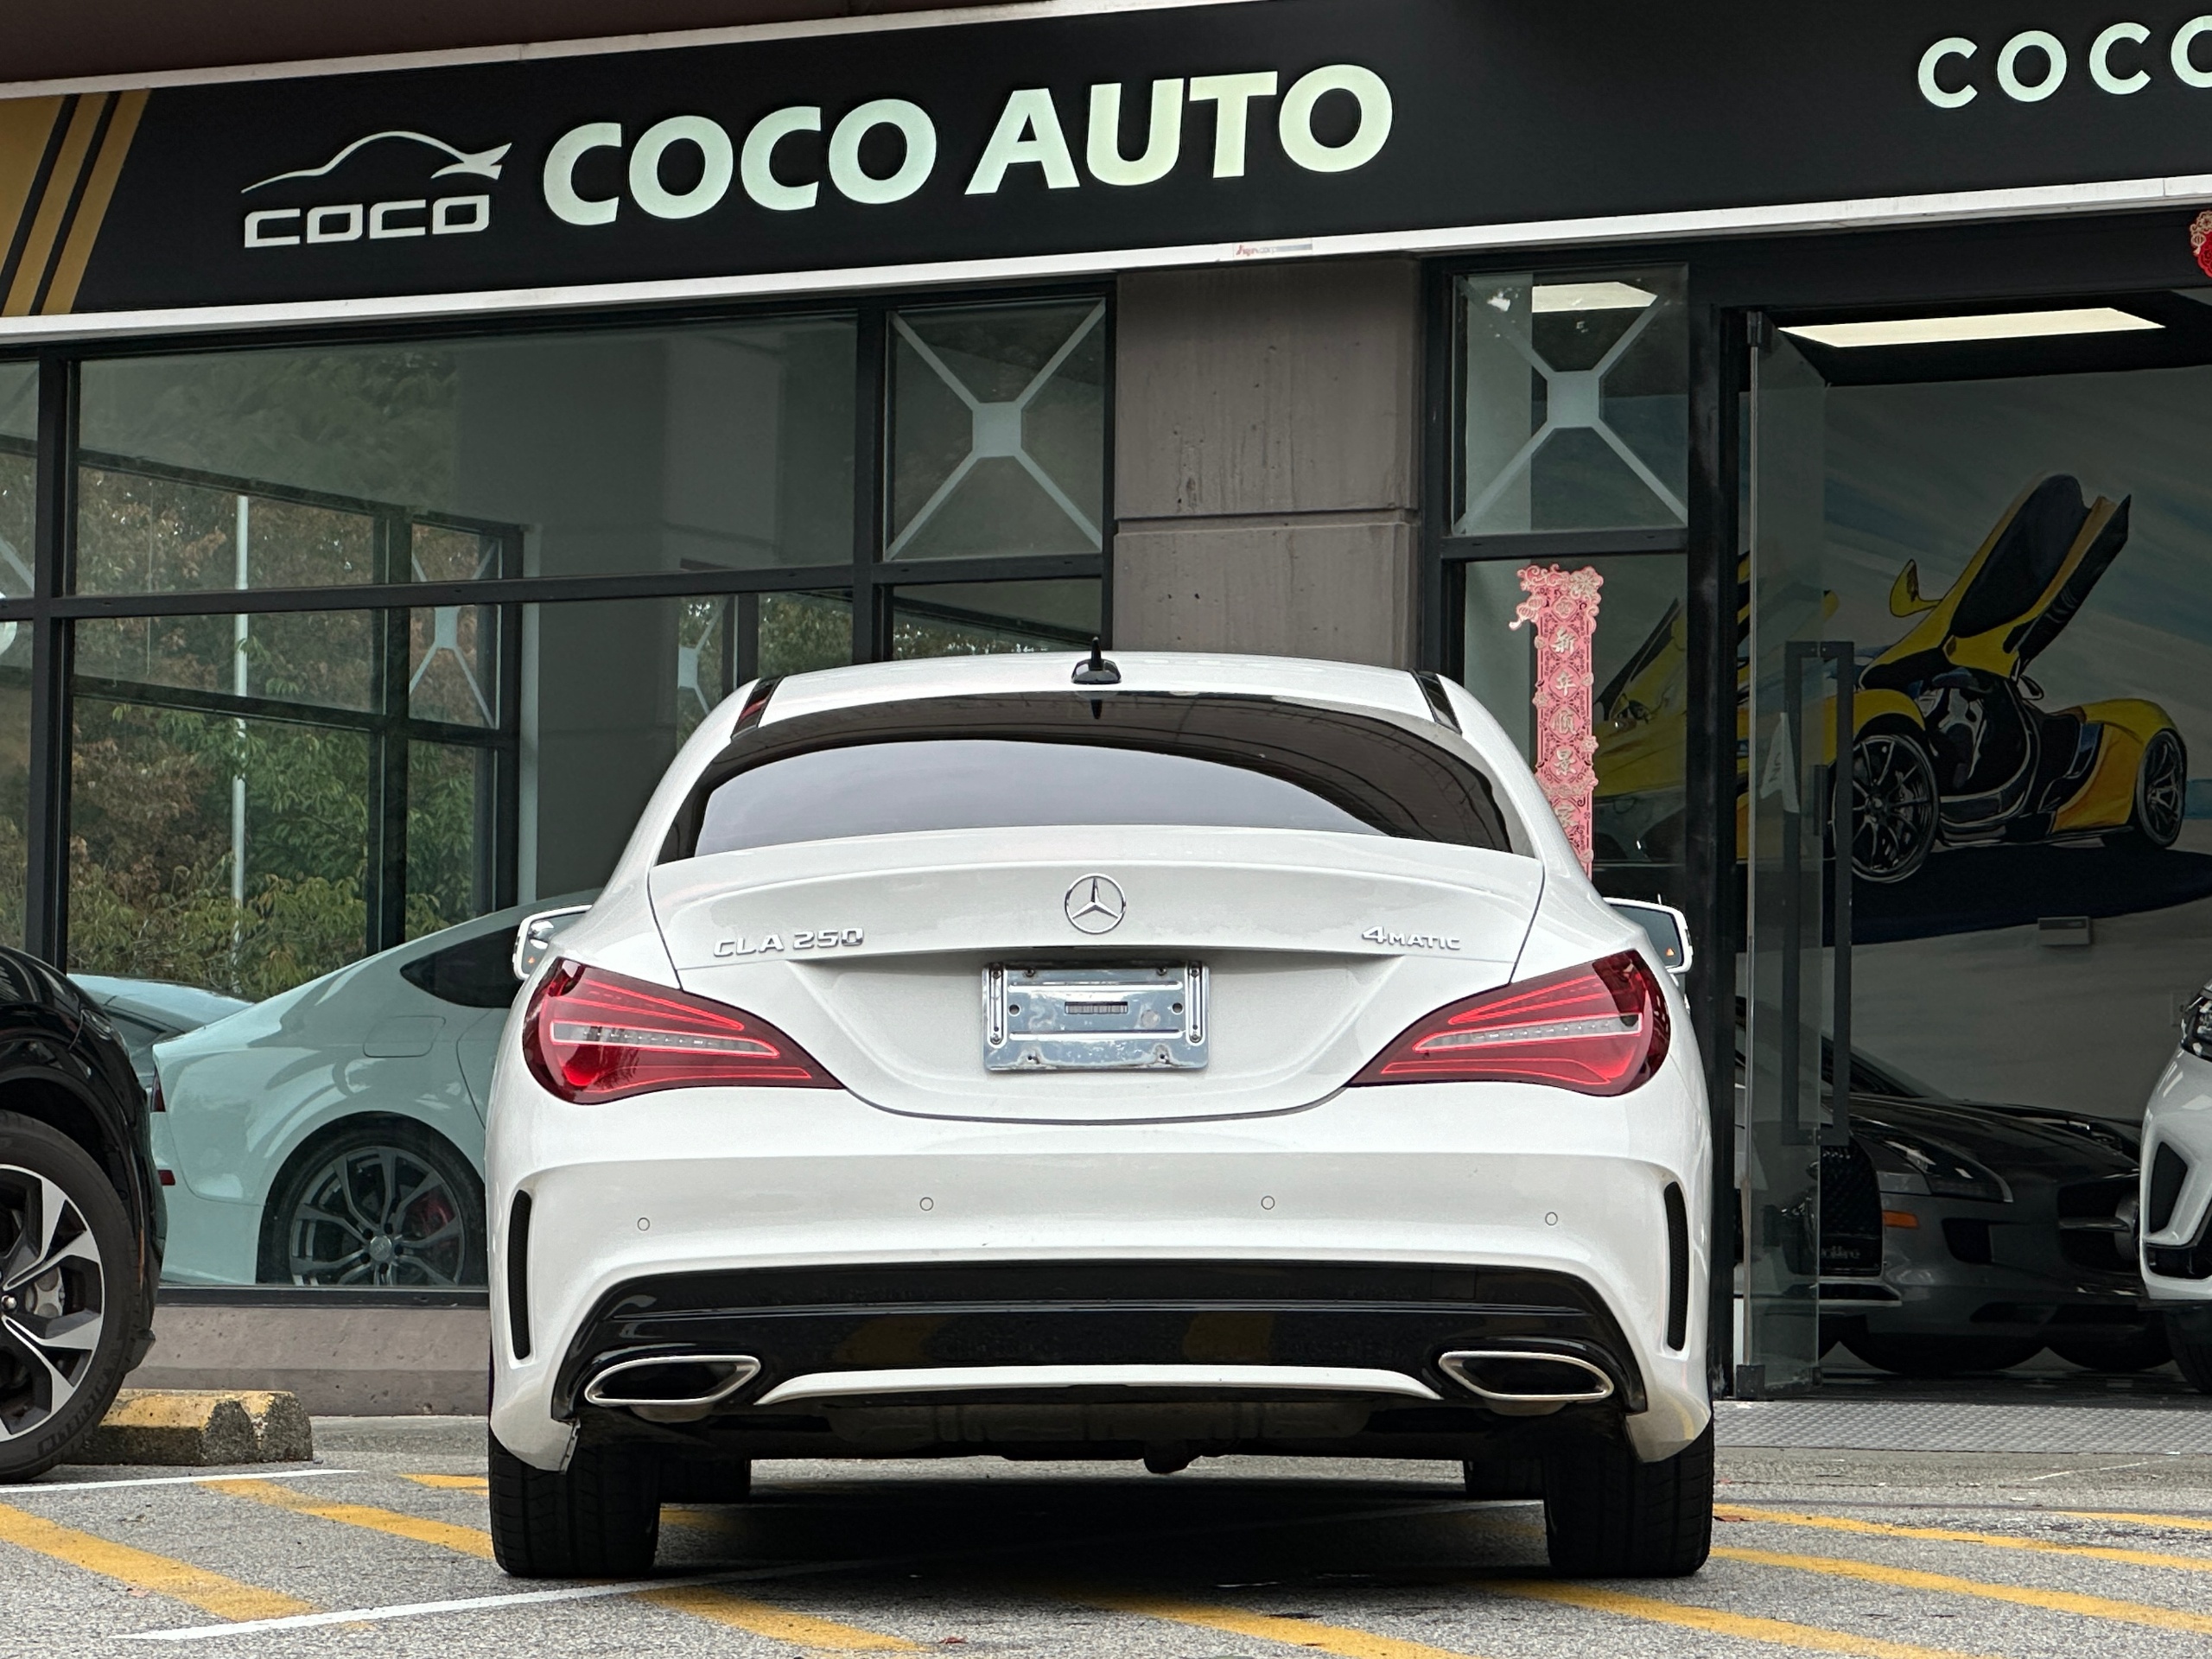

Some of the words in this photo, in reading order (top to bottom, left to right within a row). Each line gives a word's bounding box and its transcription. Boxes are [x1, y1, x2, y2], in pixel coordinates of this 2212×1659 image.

[1917, 15, 2212, 109] COCO
[543, 99, 938, 226] COCO
[964, 64, 1394, 195] AUTO
[243, 194, 491, 248] COCO
[714, 934, 785, 957] CLA
[793, 928, 864, 950] 250
[1362, 925, 1460, 950] 4MATIC
